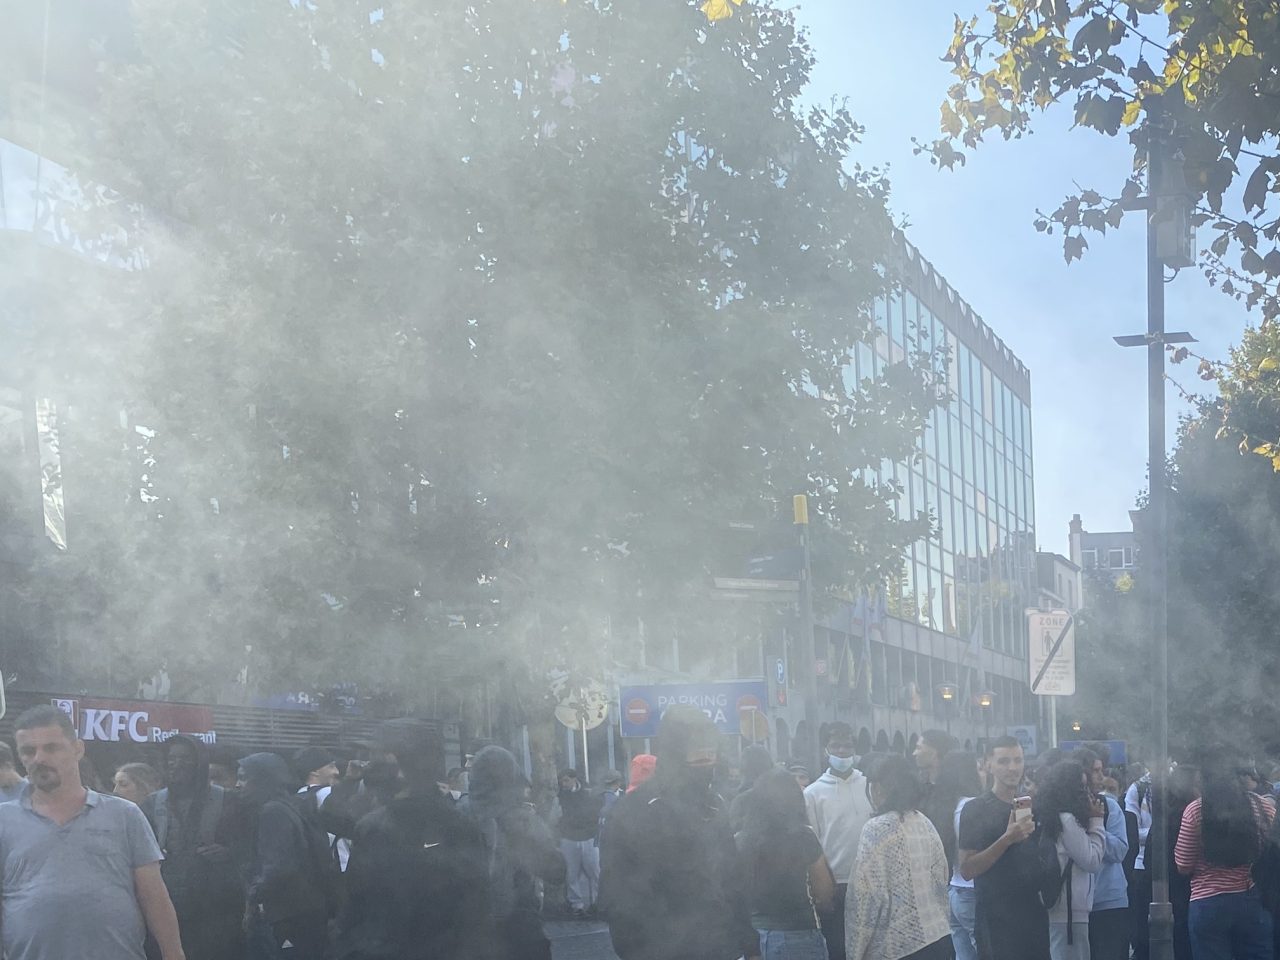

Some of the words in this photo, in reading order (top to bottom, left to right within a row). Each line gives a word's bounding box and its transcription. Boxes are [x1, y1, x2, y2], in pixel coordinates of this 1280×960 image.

[1039, 616, 1065, 626] ZONE
[82, 708, 149, 743] KFC
[152, 726, 217, 745] Restant
